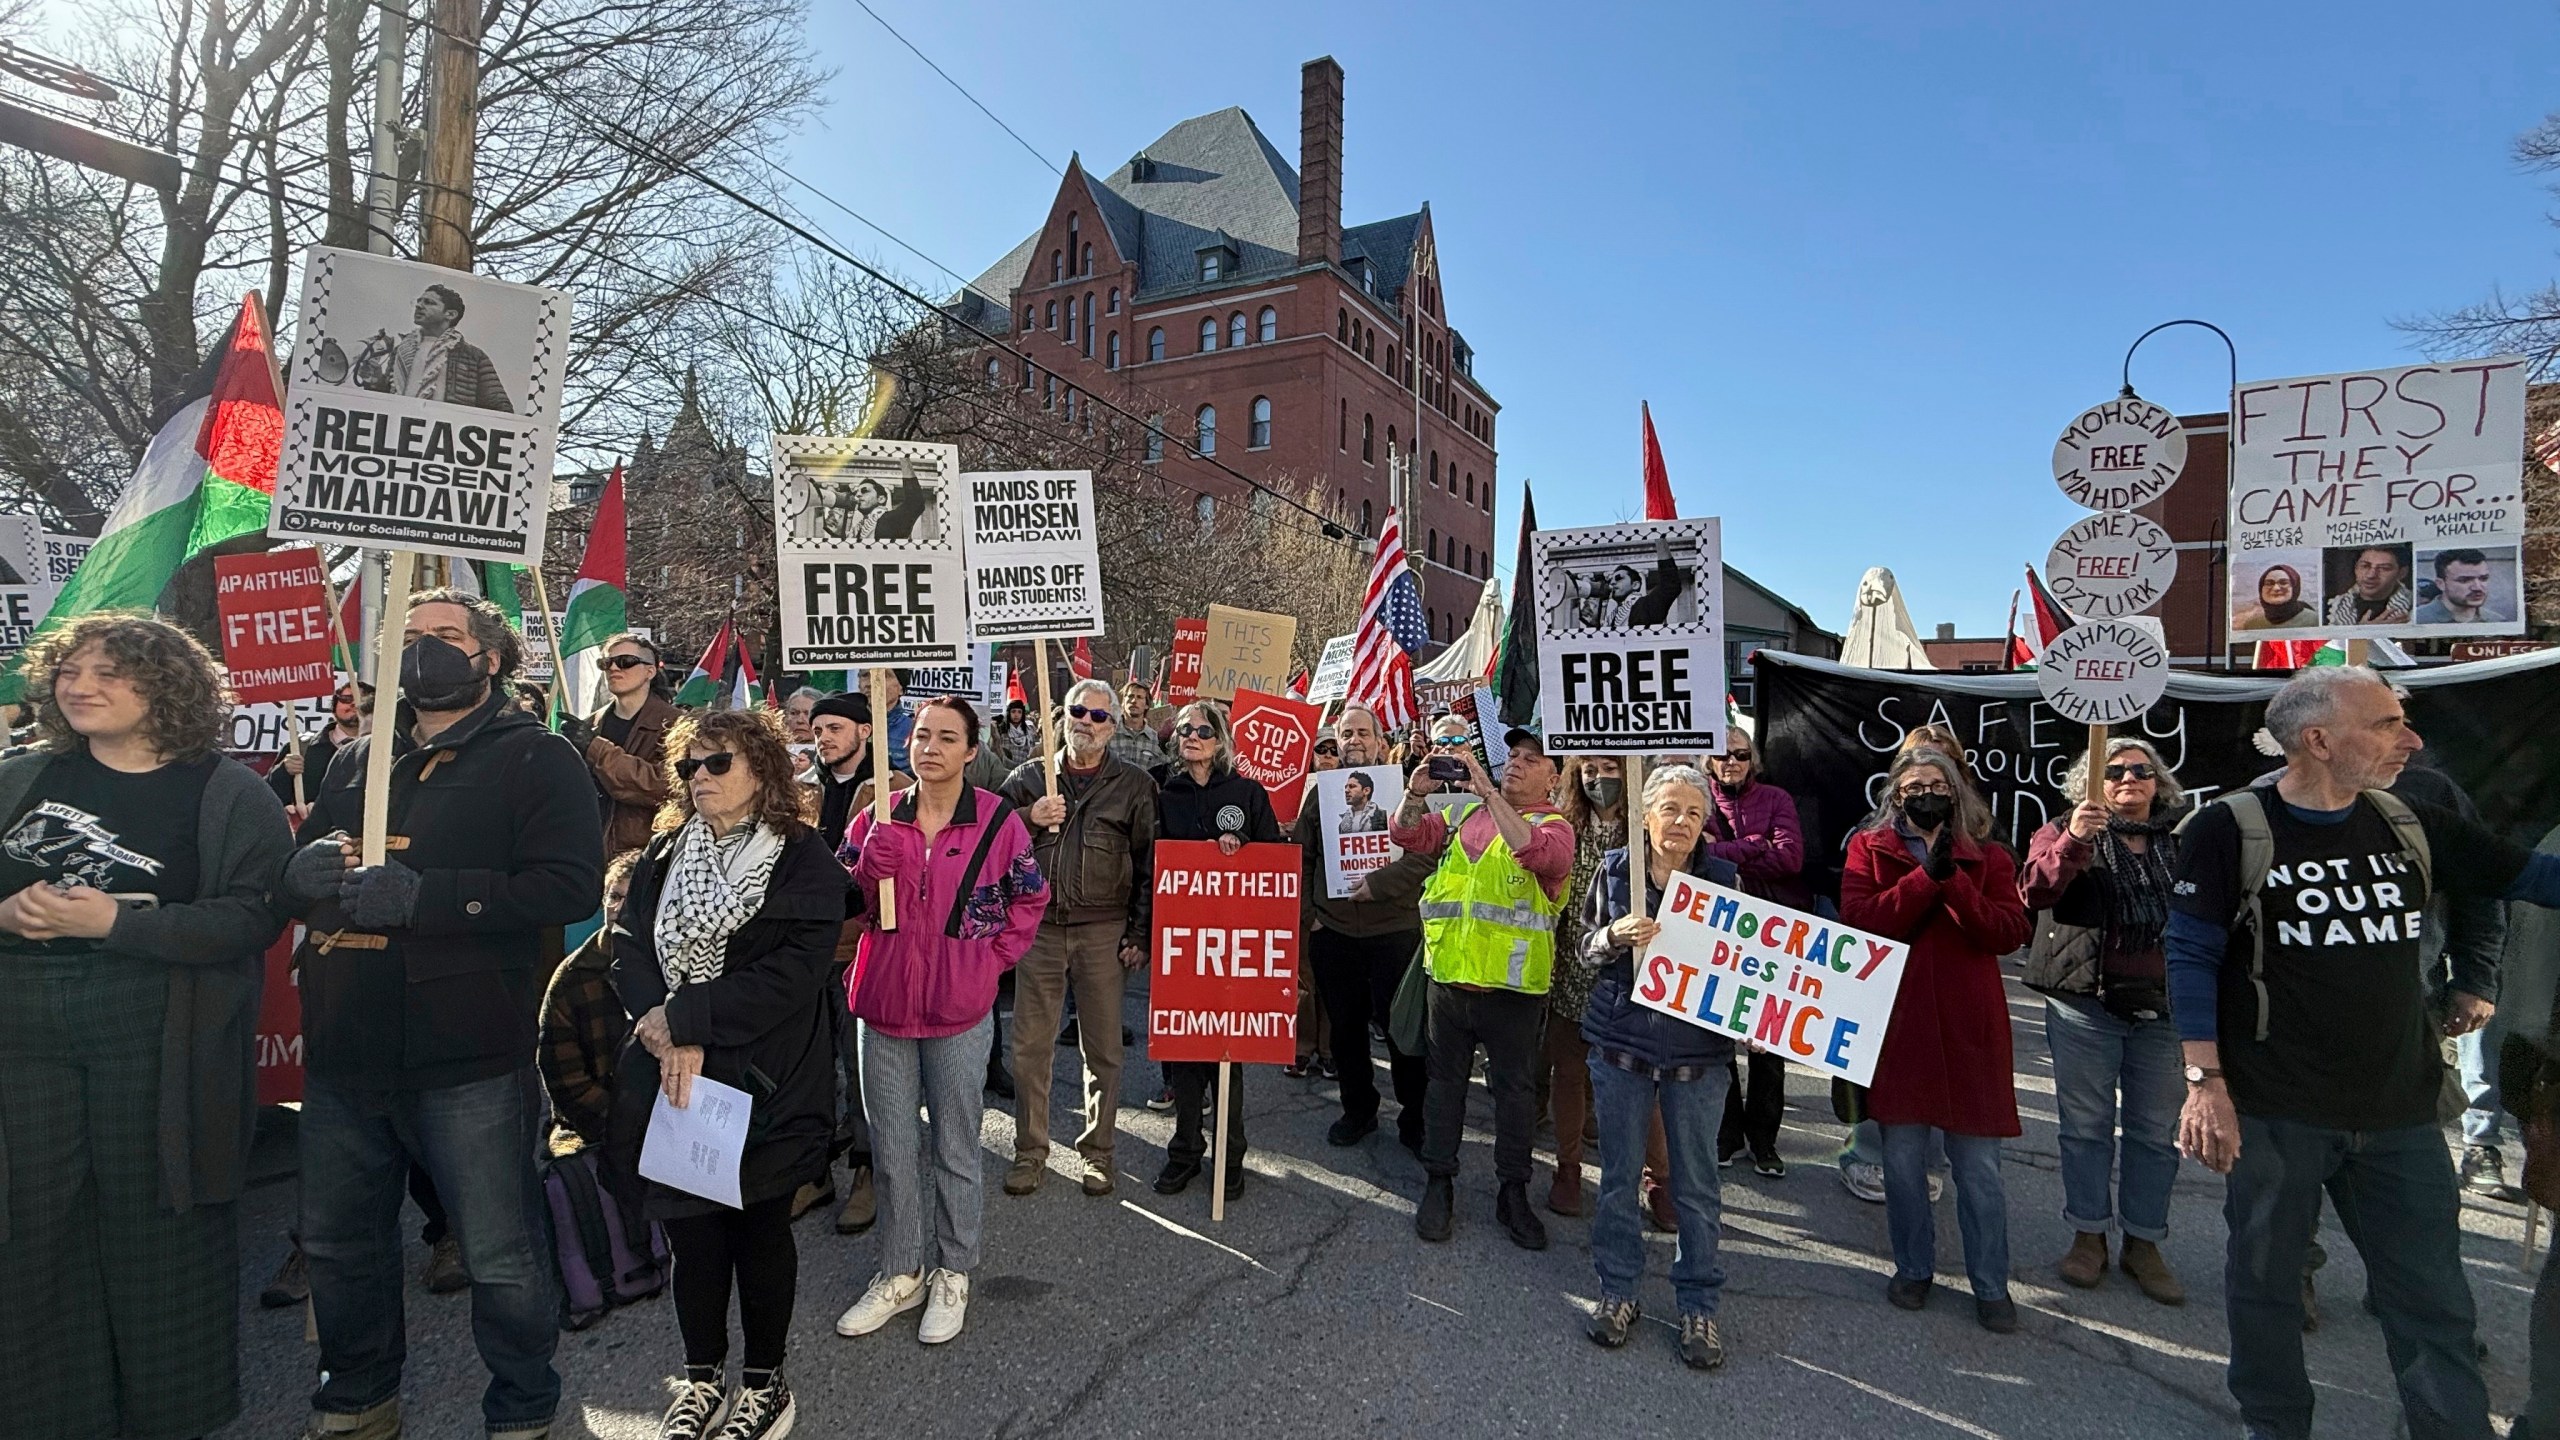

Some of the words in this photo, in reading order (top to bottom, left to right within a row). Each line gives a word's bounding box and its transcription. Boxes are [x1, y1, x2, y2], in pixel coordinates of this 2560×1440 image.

[2239, 361, 2524, 445] FIRST
[313, 406, 515, 471] RELEASE
[2060, 402, 2178, 450] MOHSEN
[2091, 444, 2148, 469] FREE
[2273, 443, 2434, 484] THEY
[310, 451, 511, 493] MOHSEN
[2057, 462, 2176, 510] MAHDAWI
[305, 473, 509, 528] MAHDAWI
[972, 480, 1039, 502] HANDS
[1044, 479, 1077, 500] OFF
[2239, 483, 2364, 524] CAME
[2387, 474, 2515, 513] FOR...
[974, 503, 1079, 531] MOHSEN
[2326, 517, 2392, 534] MOHSEN
[2424, 508, 2506, 525] MAHMOUD
[2437, 521, 2504, 537] KHALIL
[310, 518, 344, 536] Party
[347, 521, 365, 533] for
[369, 522, 429, 539] Socialism
[432, 528, 456, 542] and
[459, 532, 521, 549] Liberation
[975, 529, 1081, 544] MAHDAWI
[2055, 514, 2172, 563] RUMEYSA
[2240, 526, 2303, 542] RUMEYSA
[2331, 527, 2404, 545] MAHDAWI
[219, 566, 320, 593] APARTHEID
[977, 566, 1046, 589] HANDS
[1051, 564, 1085, 586] OFF
[2076, 553, 2140, 577] FREE!
[804, 563, 935, 615] FREE
[978, 591, 1007, 607] OUR
[1011, 587, 1086, 605] STUDENTS!
[2051, 577, 2159, 617] OZTURK
[227, 605, 324, 648] FREE
[807, 615, 936, 645] MOHSEN
[990, 625, 1006, 634] Party
[1018, 623, 1047, 631] Socialism
[1049, 622, 1060, 630] and
[1062, 621, 1092, 629] Liberation
[1222, 621, 1271, 647] THIS
[810, 653, 833, 661] Party
[835, 652, 847, 660] for
[850, 651, 892, 659] Socialism
[894, 650, 909, 658] and
[911, 650, 953, 658] Liberation
[1231, 646, 1261, 663] IS
[2044, 624, 2161, 673] MAHMOUD
[230, 662, 333, 689] COMMUNITY
[909, 669, 972, 690] MOHSEN
[1206, 665, 1282, 695] WRONG!
[1561, 649, 1691, 703] FREE
[2075, 660, 2135, 680] FREE!
[1564, 702, 1692, 731] MOHSEN
[2050, 686, 2146, 720] KHALIL
[1244, 719, 1300, 751] STOP
[1567, 739, 1589, 748] Party
[1591, 738, 1602, 746] for
[1604, 738, 1645, 746] Socialism
[1666, 736, 1711, 745] Liberation
[1858, 698, 2186, 774] SAFEY
[1234, 751, 1297, 782] KIDNAPPINGS
[1253, 745, 1284, 768] ICE
[45, 804, 85, 821] SAFETY
[105, 845, 152, 867] SOLIDARITY
[1339, 834, 1390, 856] FREE
[1340, 856, 1391, 871] MOHSEN
[2266, 858, 2349, 888] NOT
[2367, 852, 2408, 876] IN
[1157, 869, 1298, 898] APARTHEID
[2296, 881, 2404, 914] OUR
[1671, 881, 1894, 981] DEMOCRACY
[2277, 910, 2421, 946] NAME
[1161, 927, 1293, 978] FREE
[1711, 940, 1779, 983] Dies
[1788, 965, 1822, 999] in
[1153, 1009, 1297, 1038] COMMUNITY
[1639, 955, 1860, 1070] SILENCE
